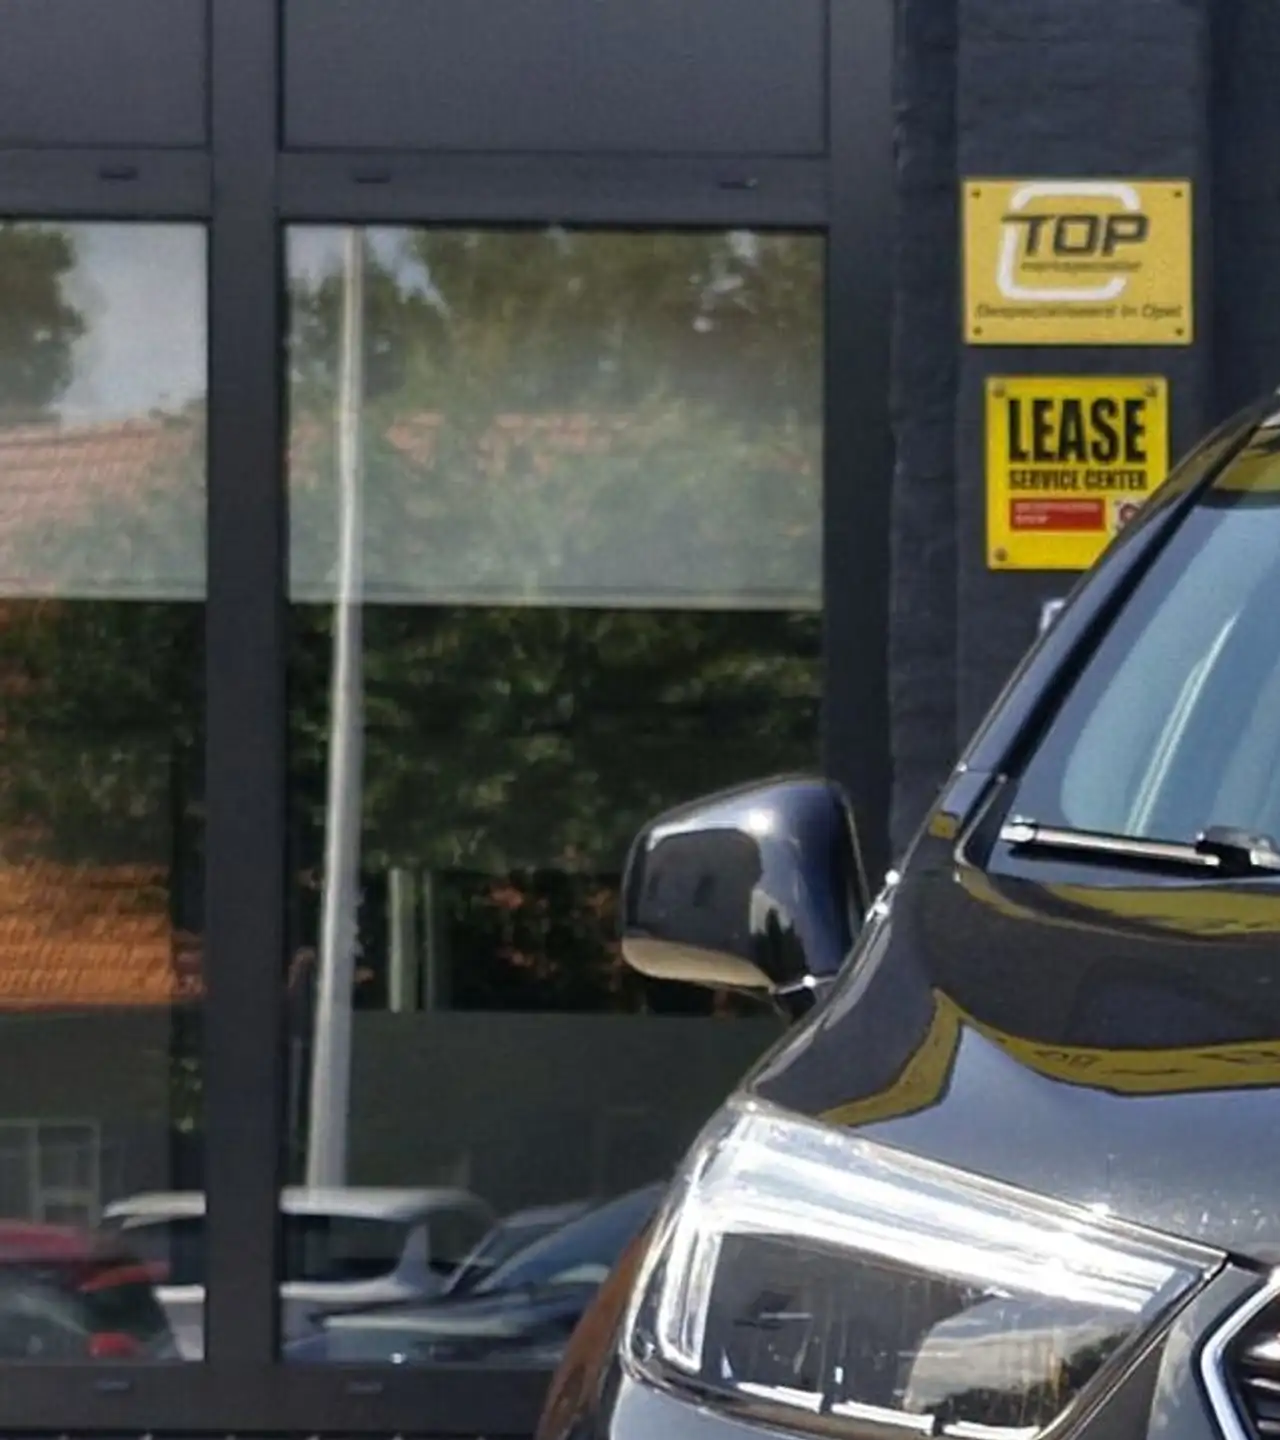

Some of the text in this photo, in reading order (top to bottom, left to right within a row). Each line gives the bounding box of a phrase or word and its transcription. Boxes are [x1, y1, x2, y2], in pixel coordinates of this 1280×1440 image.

[1001, 213, 1149, 257] TOP
[1007, 398, 1147, 464] LEASE
[1009, 469, 1147, 491] SERVICE CENTER
